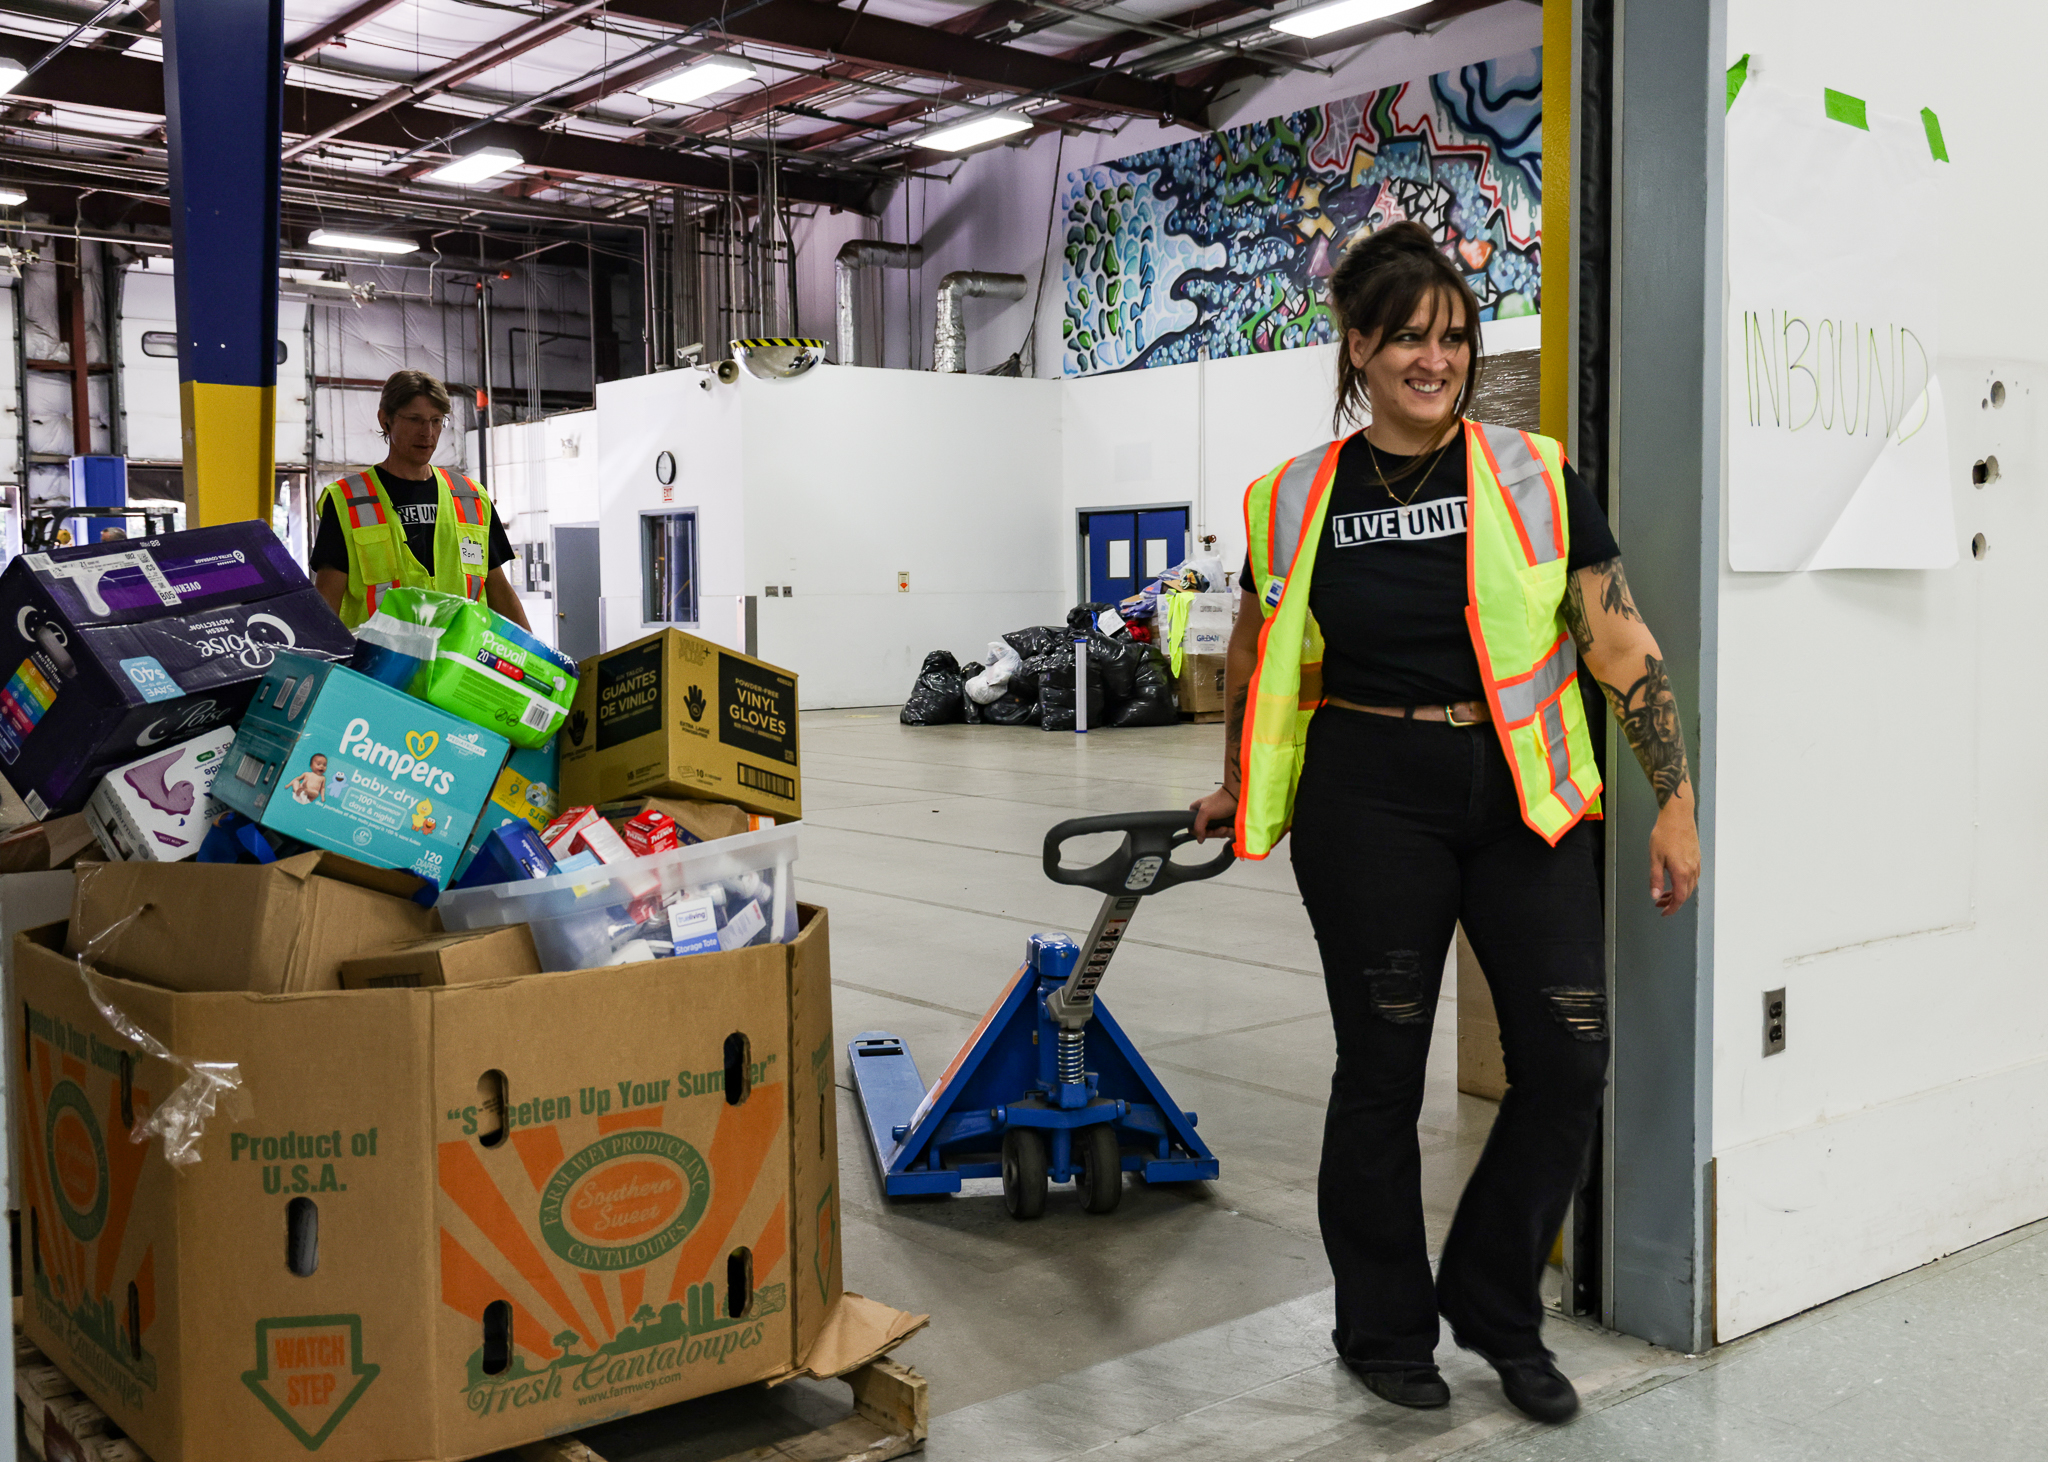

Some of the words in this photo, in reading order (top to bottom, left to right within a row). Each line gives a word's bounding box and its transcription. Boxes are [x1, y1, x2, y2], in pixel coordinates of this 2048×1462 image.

[1744, 308, 1929, 446] INBOUND
[1337, 512, 1399, 544] LIVE
[461, 547, 476, 559] Ron
[205, 626, 230, 635] FRESH
[477, 649, 490, 664] 20
[482, 630, 528, 667] Prevail
[130, 667, 166, 684] $40
[145, 684, 176, 697] SAVE
[602, 669, 657, 701] GUANTES
[735, 677, 780, 699] POWDER-FREE
[600, 701, 617, 720] DE
[618, 687, 658, 712] VINILO
[737, 687, 779, 715] VINYL
[729, 704, 787, 735] GLOVES
[338, 717, 455, 795] Pampers
[351, 769, 420, 810] baby-dry
[348, 801, 366, 813] days
[366, 807, 373, 815] &
[373, 810, 397, 825] nights
[651, 825, 675, 844] TYLENOL
[415, 858, 442, 874] DIAPERS
[424, 850, 443, 865] 120
[675, 942, 703, 955] Storage
[702, 937, 717, 947] Tote
[447, 1095, 572, 1136] “Seeten
[579, 1086, 611, 1117] Up
[617, 1078, 671, 1110] Your
[677, 1054, 777, 1099] Sumer”
[230, 1129, 343, 1162] Product
[351, 1127, 378, 1158] of
[262, 1163, 347, 1195] U.S.A.
[576, 1173, 676, 1210] Southern
[594, 1202, 662, 1233] Sweet
[567, 1220, 689, 1267] CANTALOUPES
[274, 1334, 346, 1369] WATCH
[466, 1363, 563, 1419] Fresh
[572, 1321, 765, 1393] Cantaloupes
[286, 1372, 337, 1407] STEP
[577, 1371, 682, 1407] www.farmwey.com
